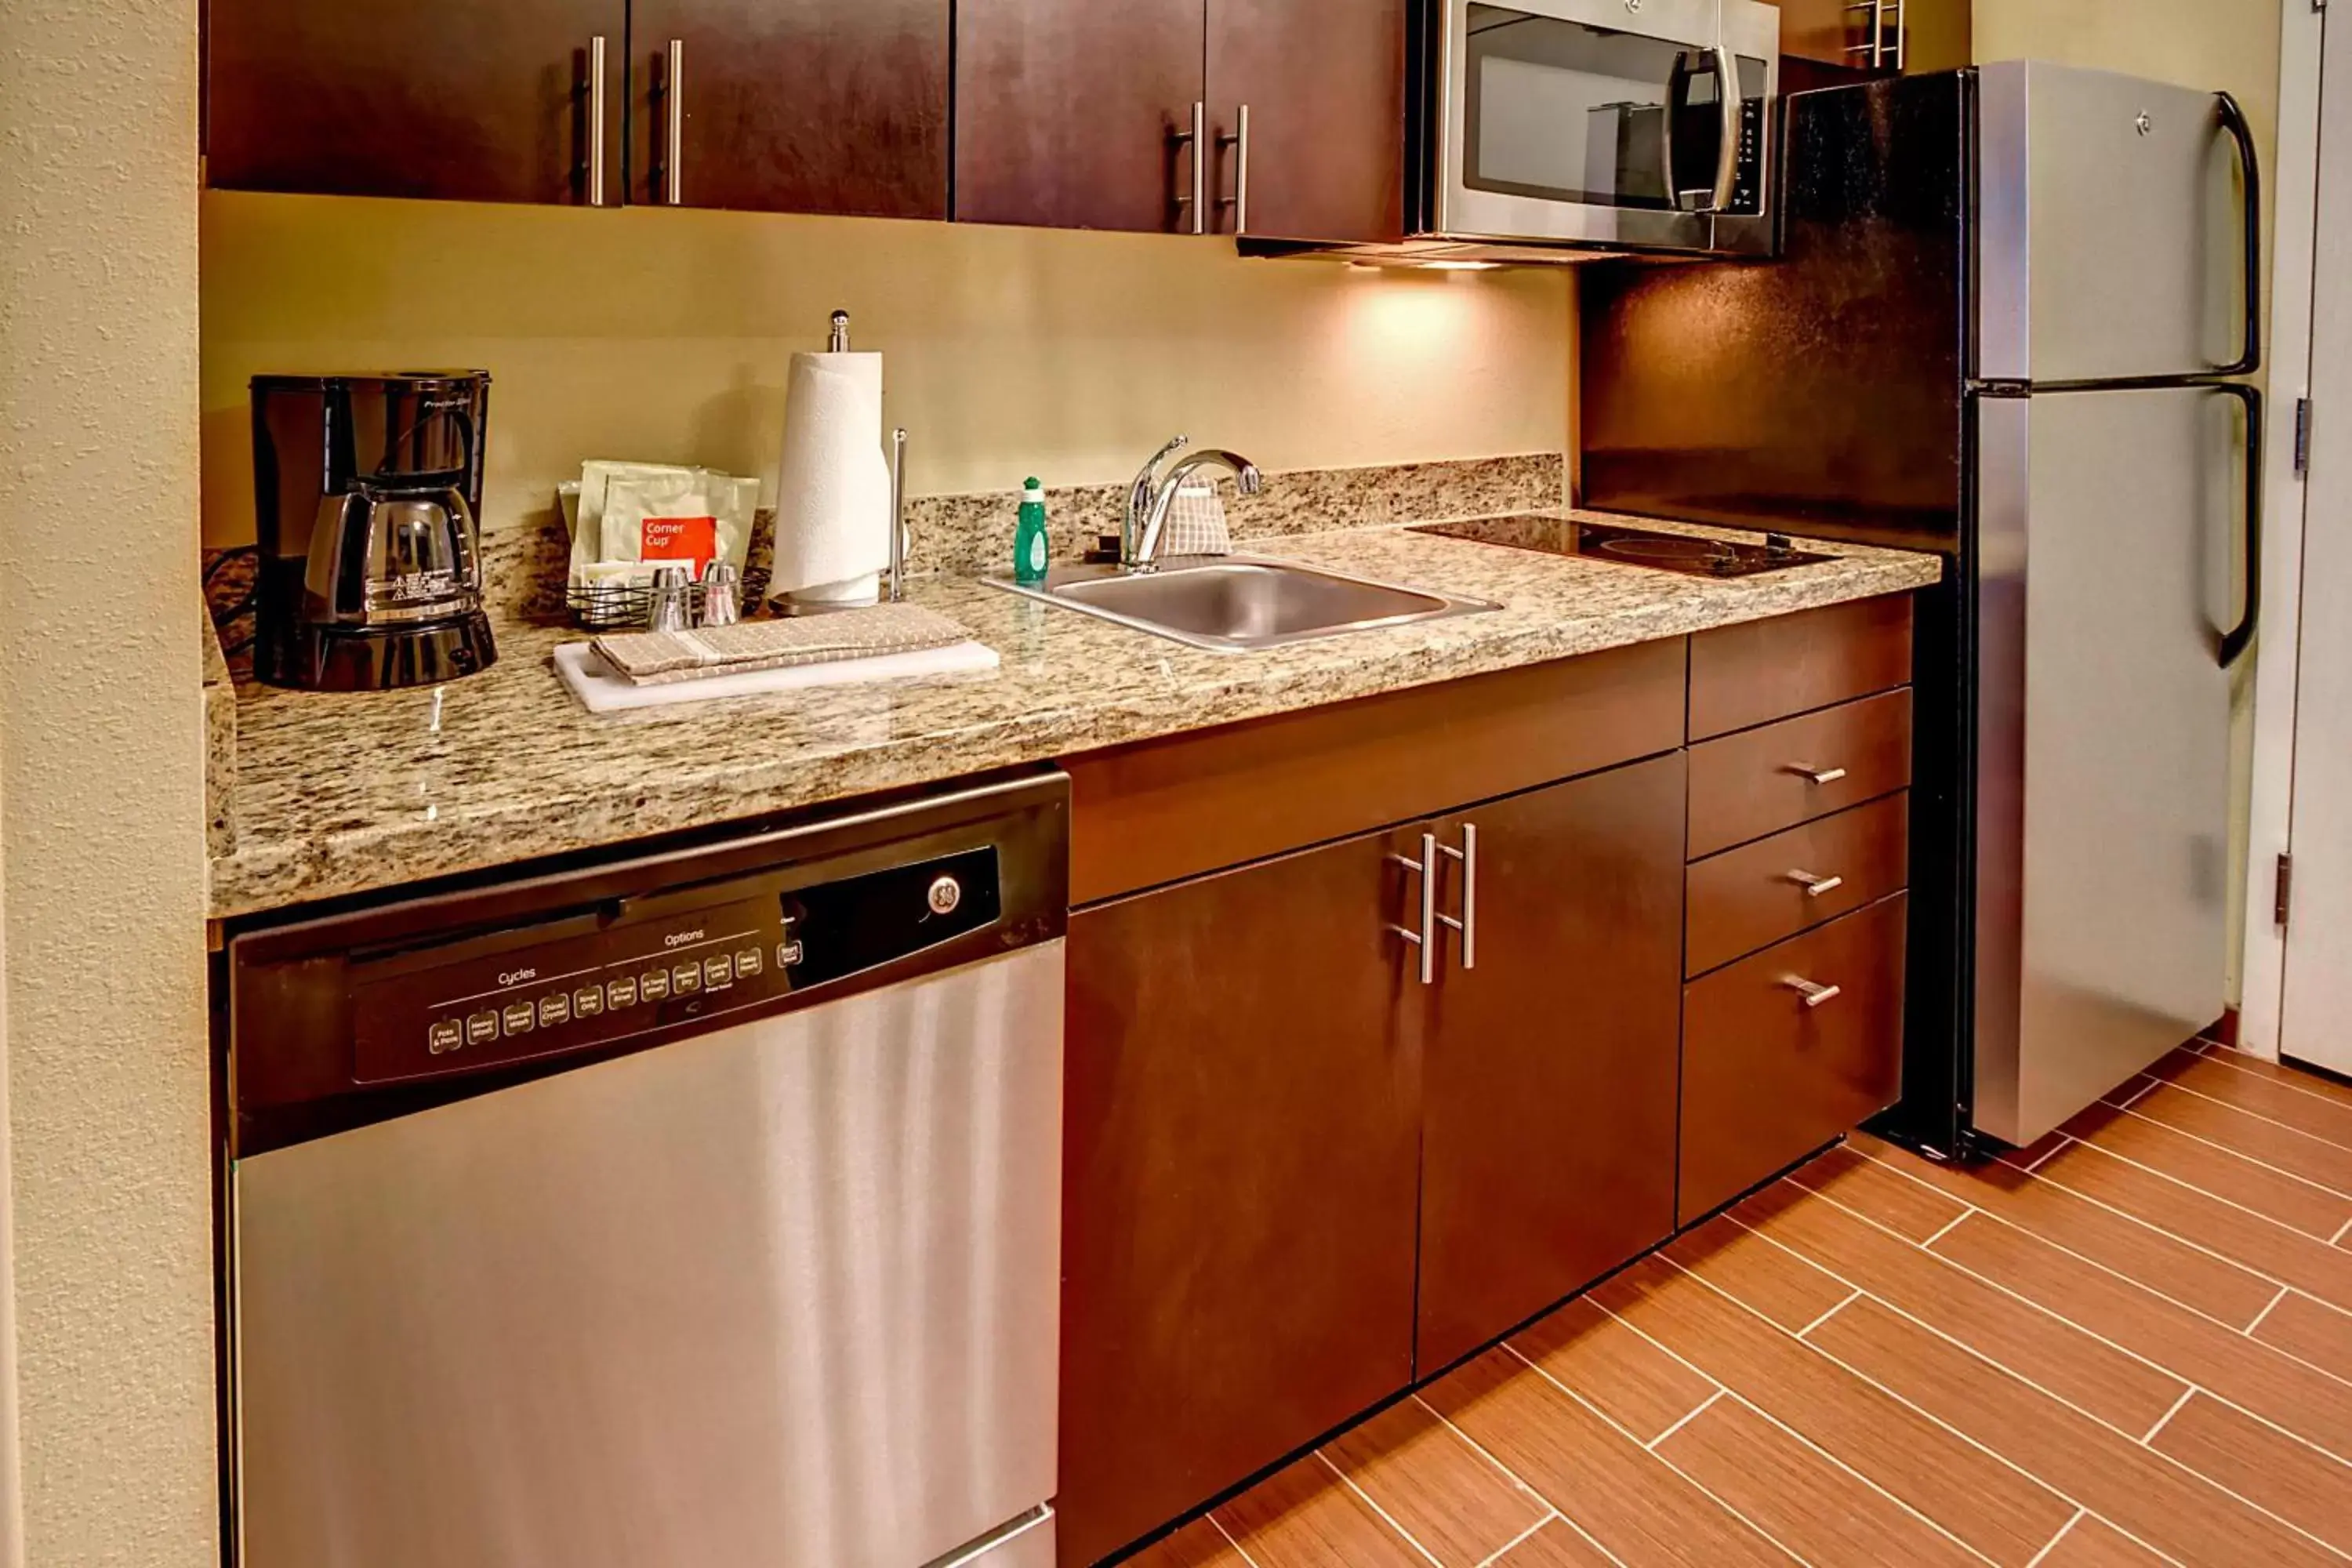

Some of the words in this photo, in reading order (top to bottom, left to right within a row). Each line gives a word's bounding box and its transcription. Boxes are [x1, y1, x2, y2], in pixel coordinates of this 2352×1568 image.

[646, 523, 685, 534] Corner
[645, 534, 670, 548] Cup
[664, 929, 704, 946] Options
[498, 967, 536, 985] Cycles
